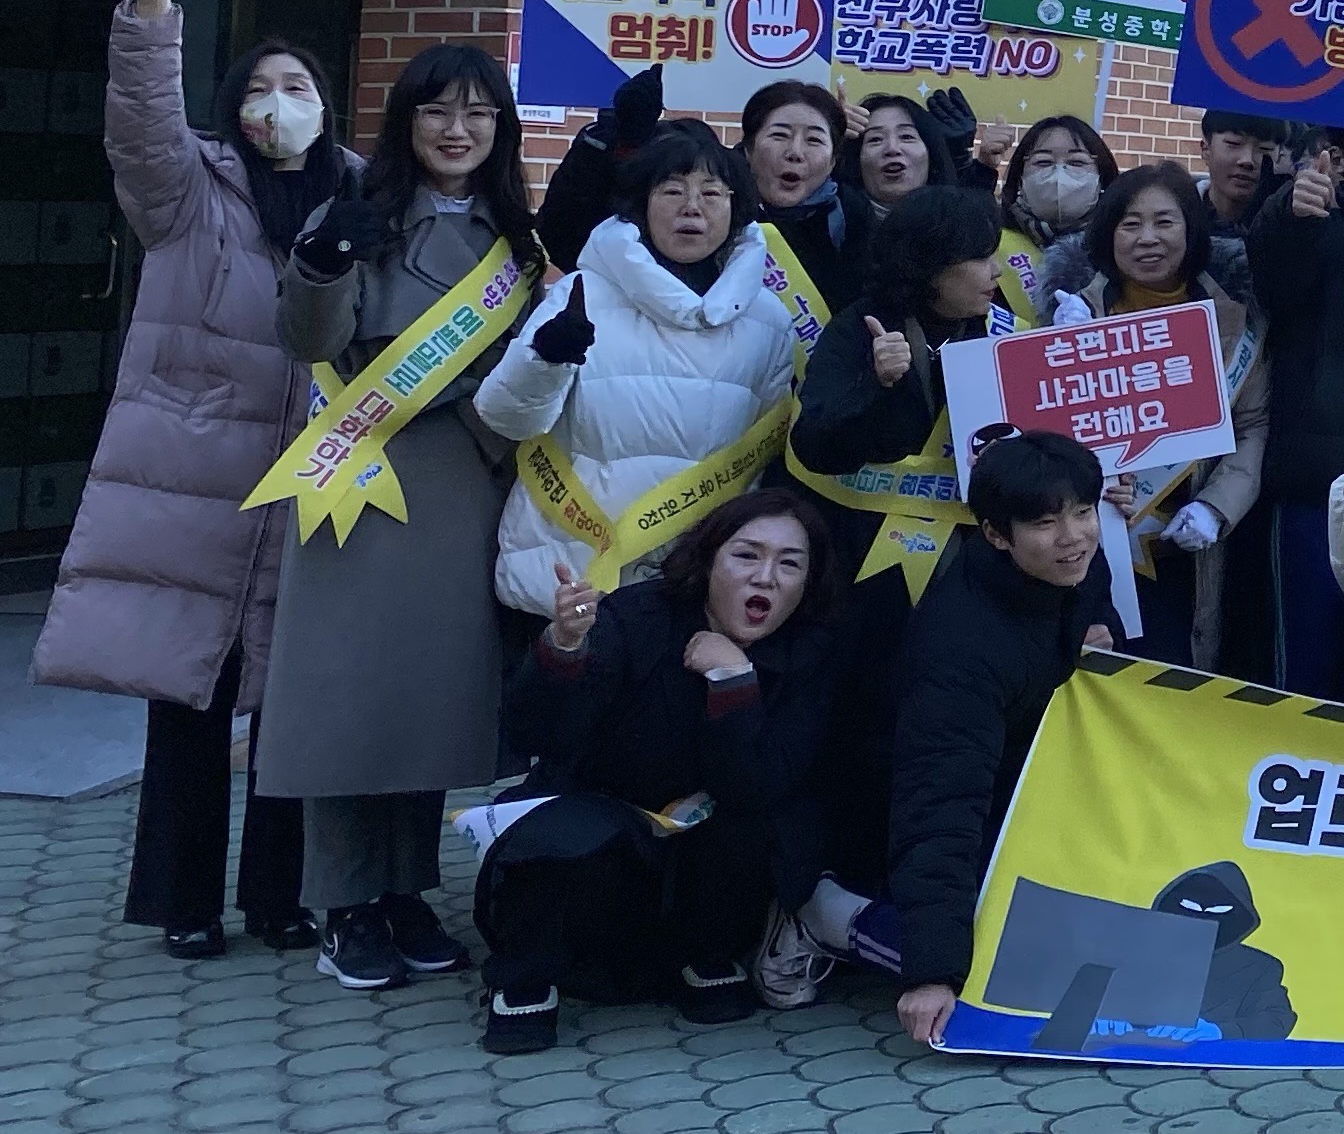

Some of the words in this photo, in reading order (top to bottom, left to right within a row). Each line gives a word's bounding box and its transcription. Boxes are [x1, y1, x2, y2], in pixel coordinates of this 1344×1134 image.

[607, 12, 715, 62] 멈춰!
[752, 23, 793, 37] STOP
[1071, 6, 1184, 43] 분성중학
[835, 27, 989, 70] 학교폭력
[994, 38, 1053, 70] NO
[1044, 318, 1174, 368] 손편지로
[1035, 355, 1194, 412] 사과마음을
[296, 389, 397, 489] 대화하기
[1070, 400, 1169, 444] 전해요
